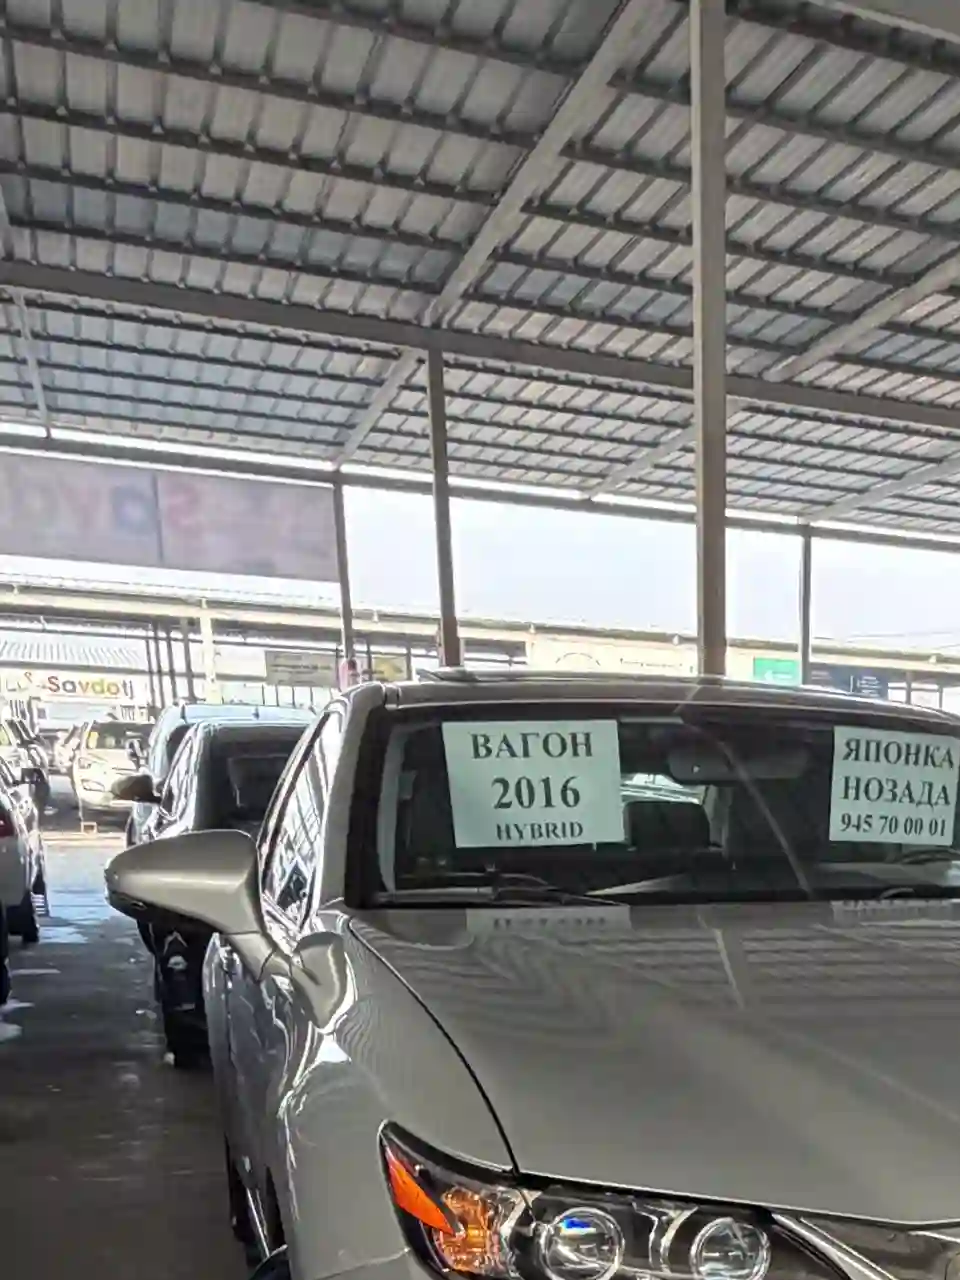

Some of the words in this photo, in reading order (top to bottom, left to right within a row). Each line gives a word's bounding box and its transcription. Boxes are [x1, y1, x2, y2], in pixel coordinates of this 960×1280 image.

[469, 731, 594, 760] ВАГОН
[842, 738, 954, 769] ЯПОНКА
[491, 776, 581, 809] 2016
[841, 775, 951, 811] НОЗАДА
[495, 820, 584, 841] HYBRID
[840, 813, 873, 833] 945
[879, 815, 898, 835] 70
[903, 816, 924, 836] 00
[929, 817, 946, 837] 01
